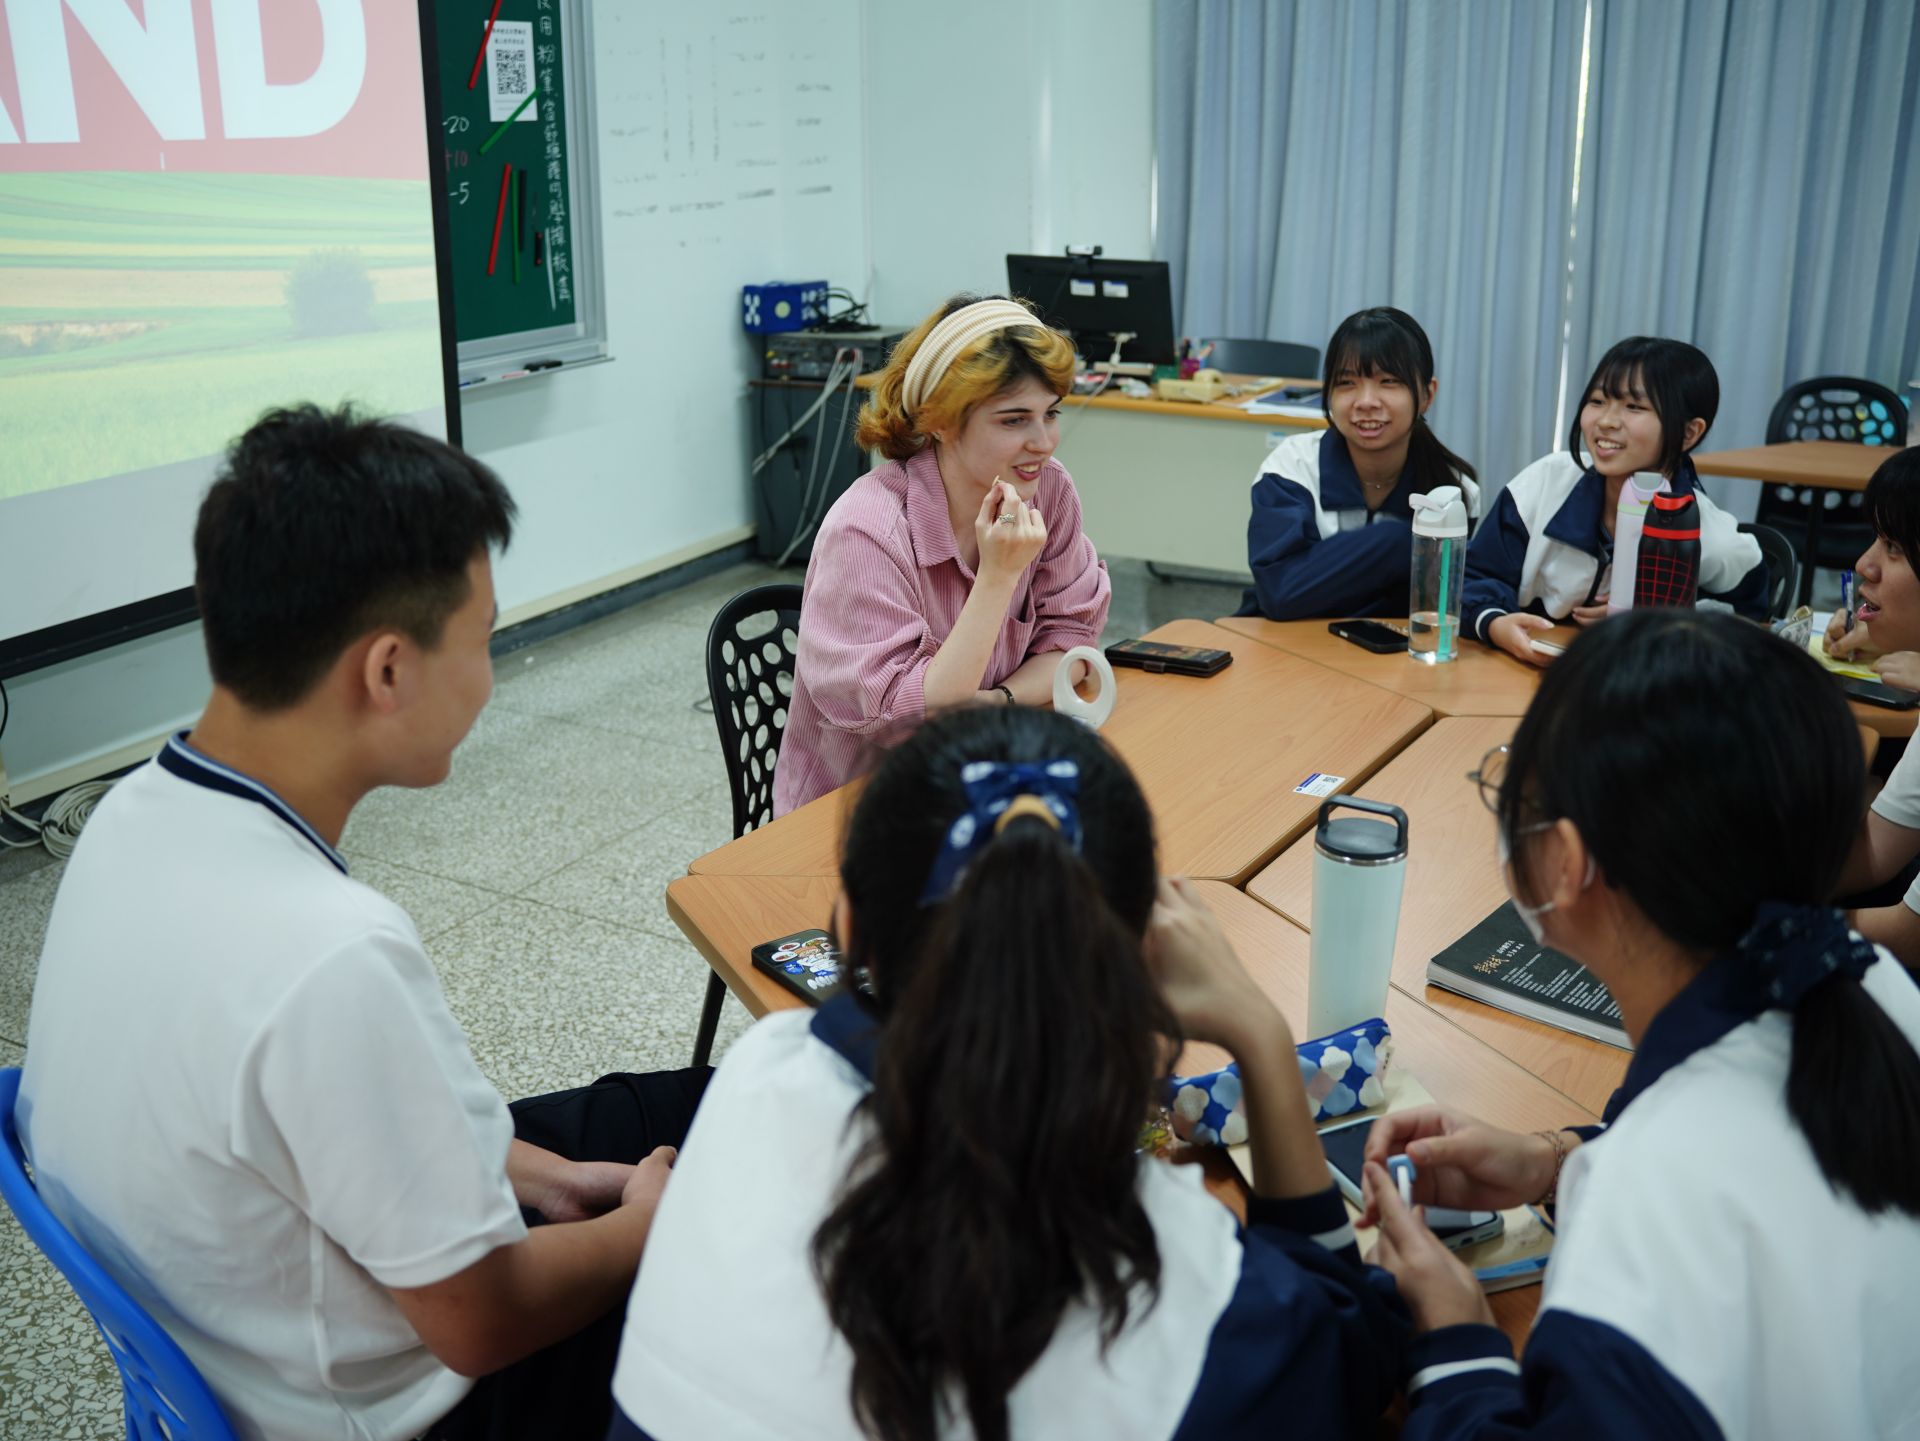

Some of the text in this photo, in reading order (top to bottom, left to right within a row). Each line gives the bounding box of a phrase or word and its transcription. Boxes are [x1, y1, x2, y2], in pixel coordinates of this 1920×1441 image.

[0, 0, 366, 143] ND
[442, 115, 470, 134] -20
[449, 181, 470, 205] -5
